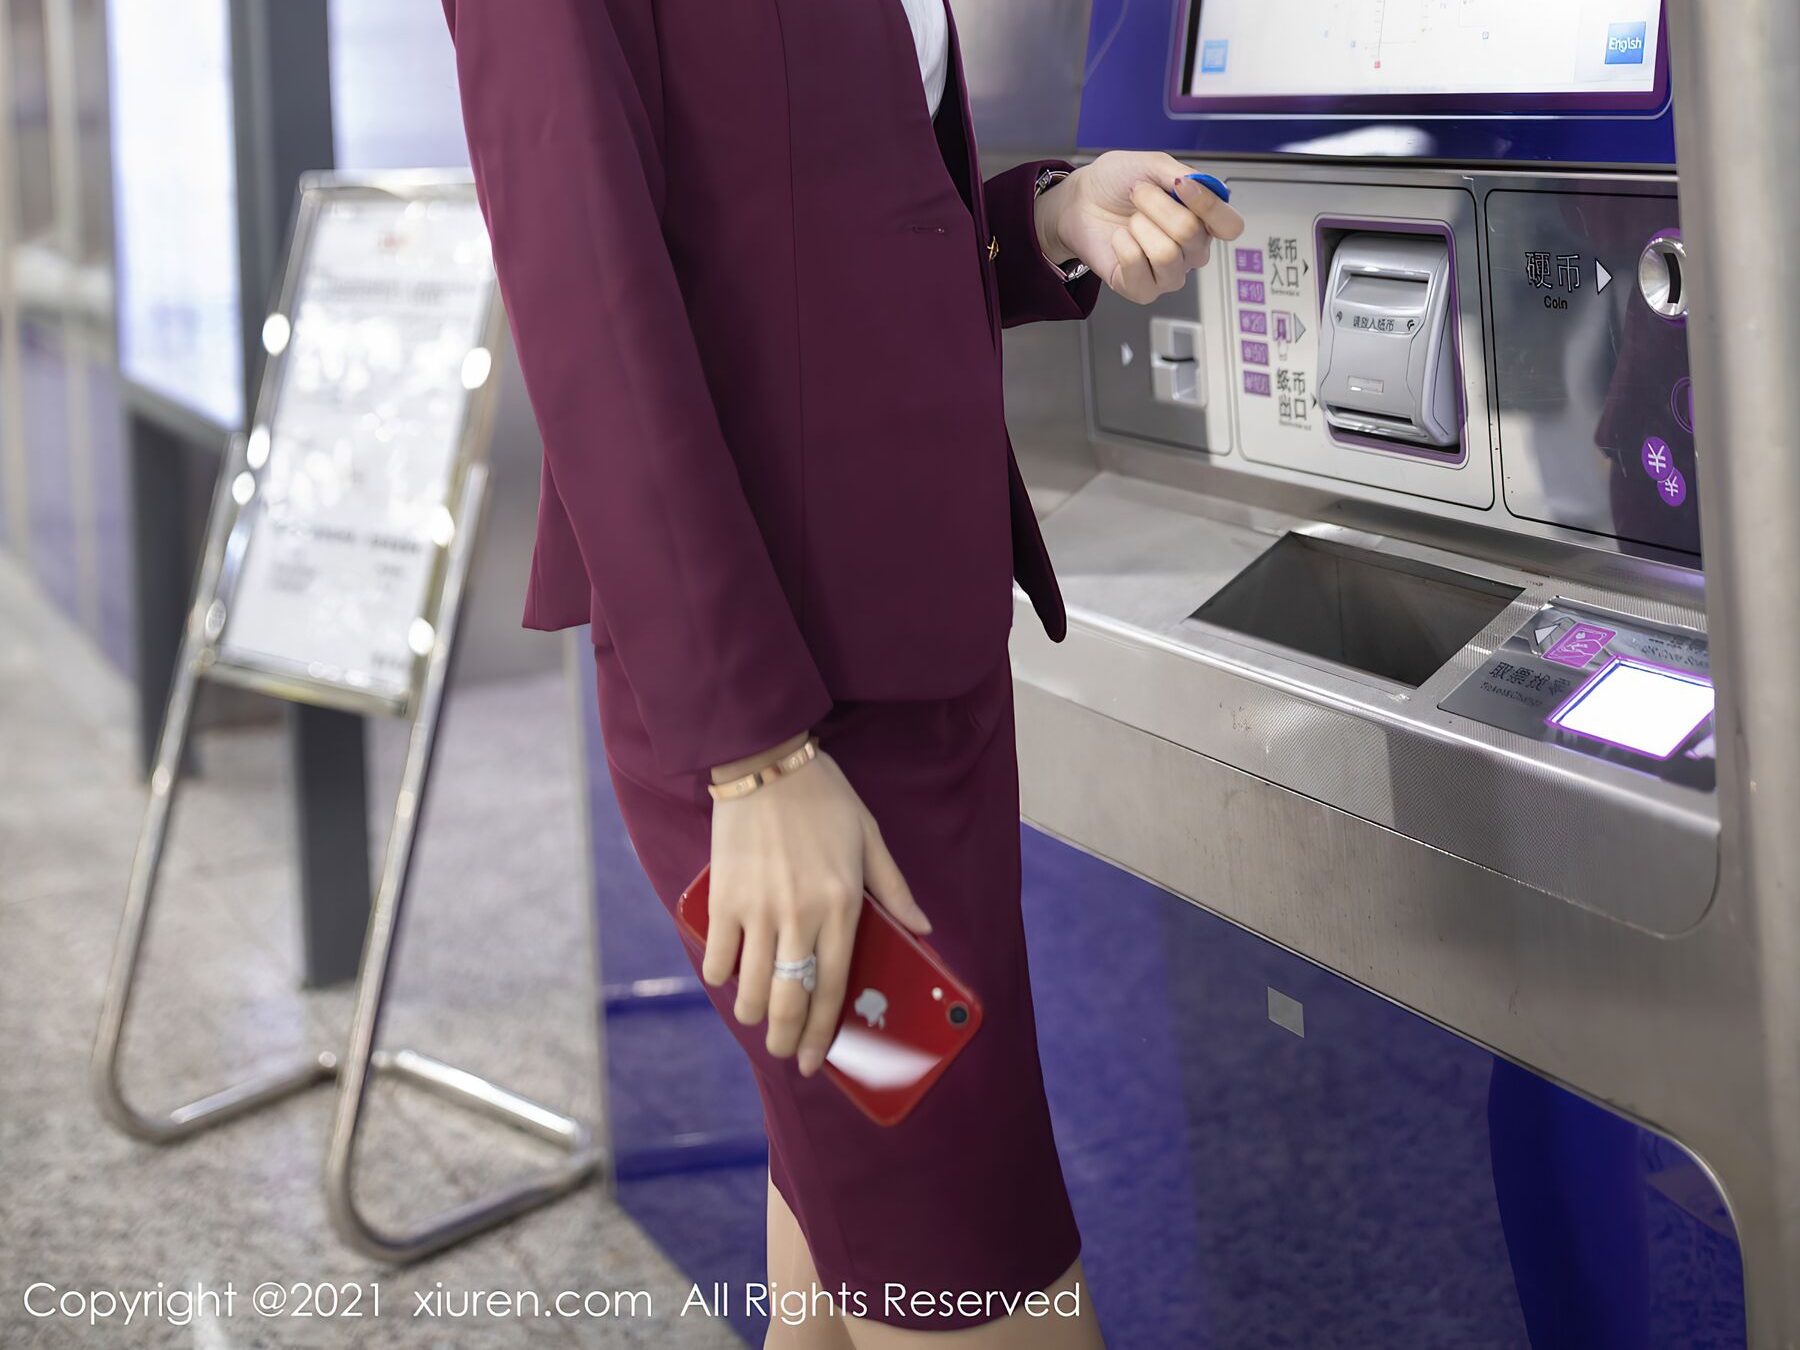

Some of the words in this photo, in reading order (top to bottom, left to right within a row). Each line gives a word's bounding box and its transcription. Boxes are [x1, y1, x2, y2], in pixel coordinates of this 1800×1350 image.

[1270, 263, 1299, 288] 入口
[1525, 252, 1581, 293] 硬币
[1544, 295, 1568, 310] Coin
